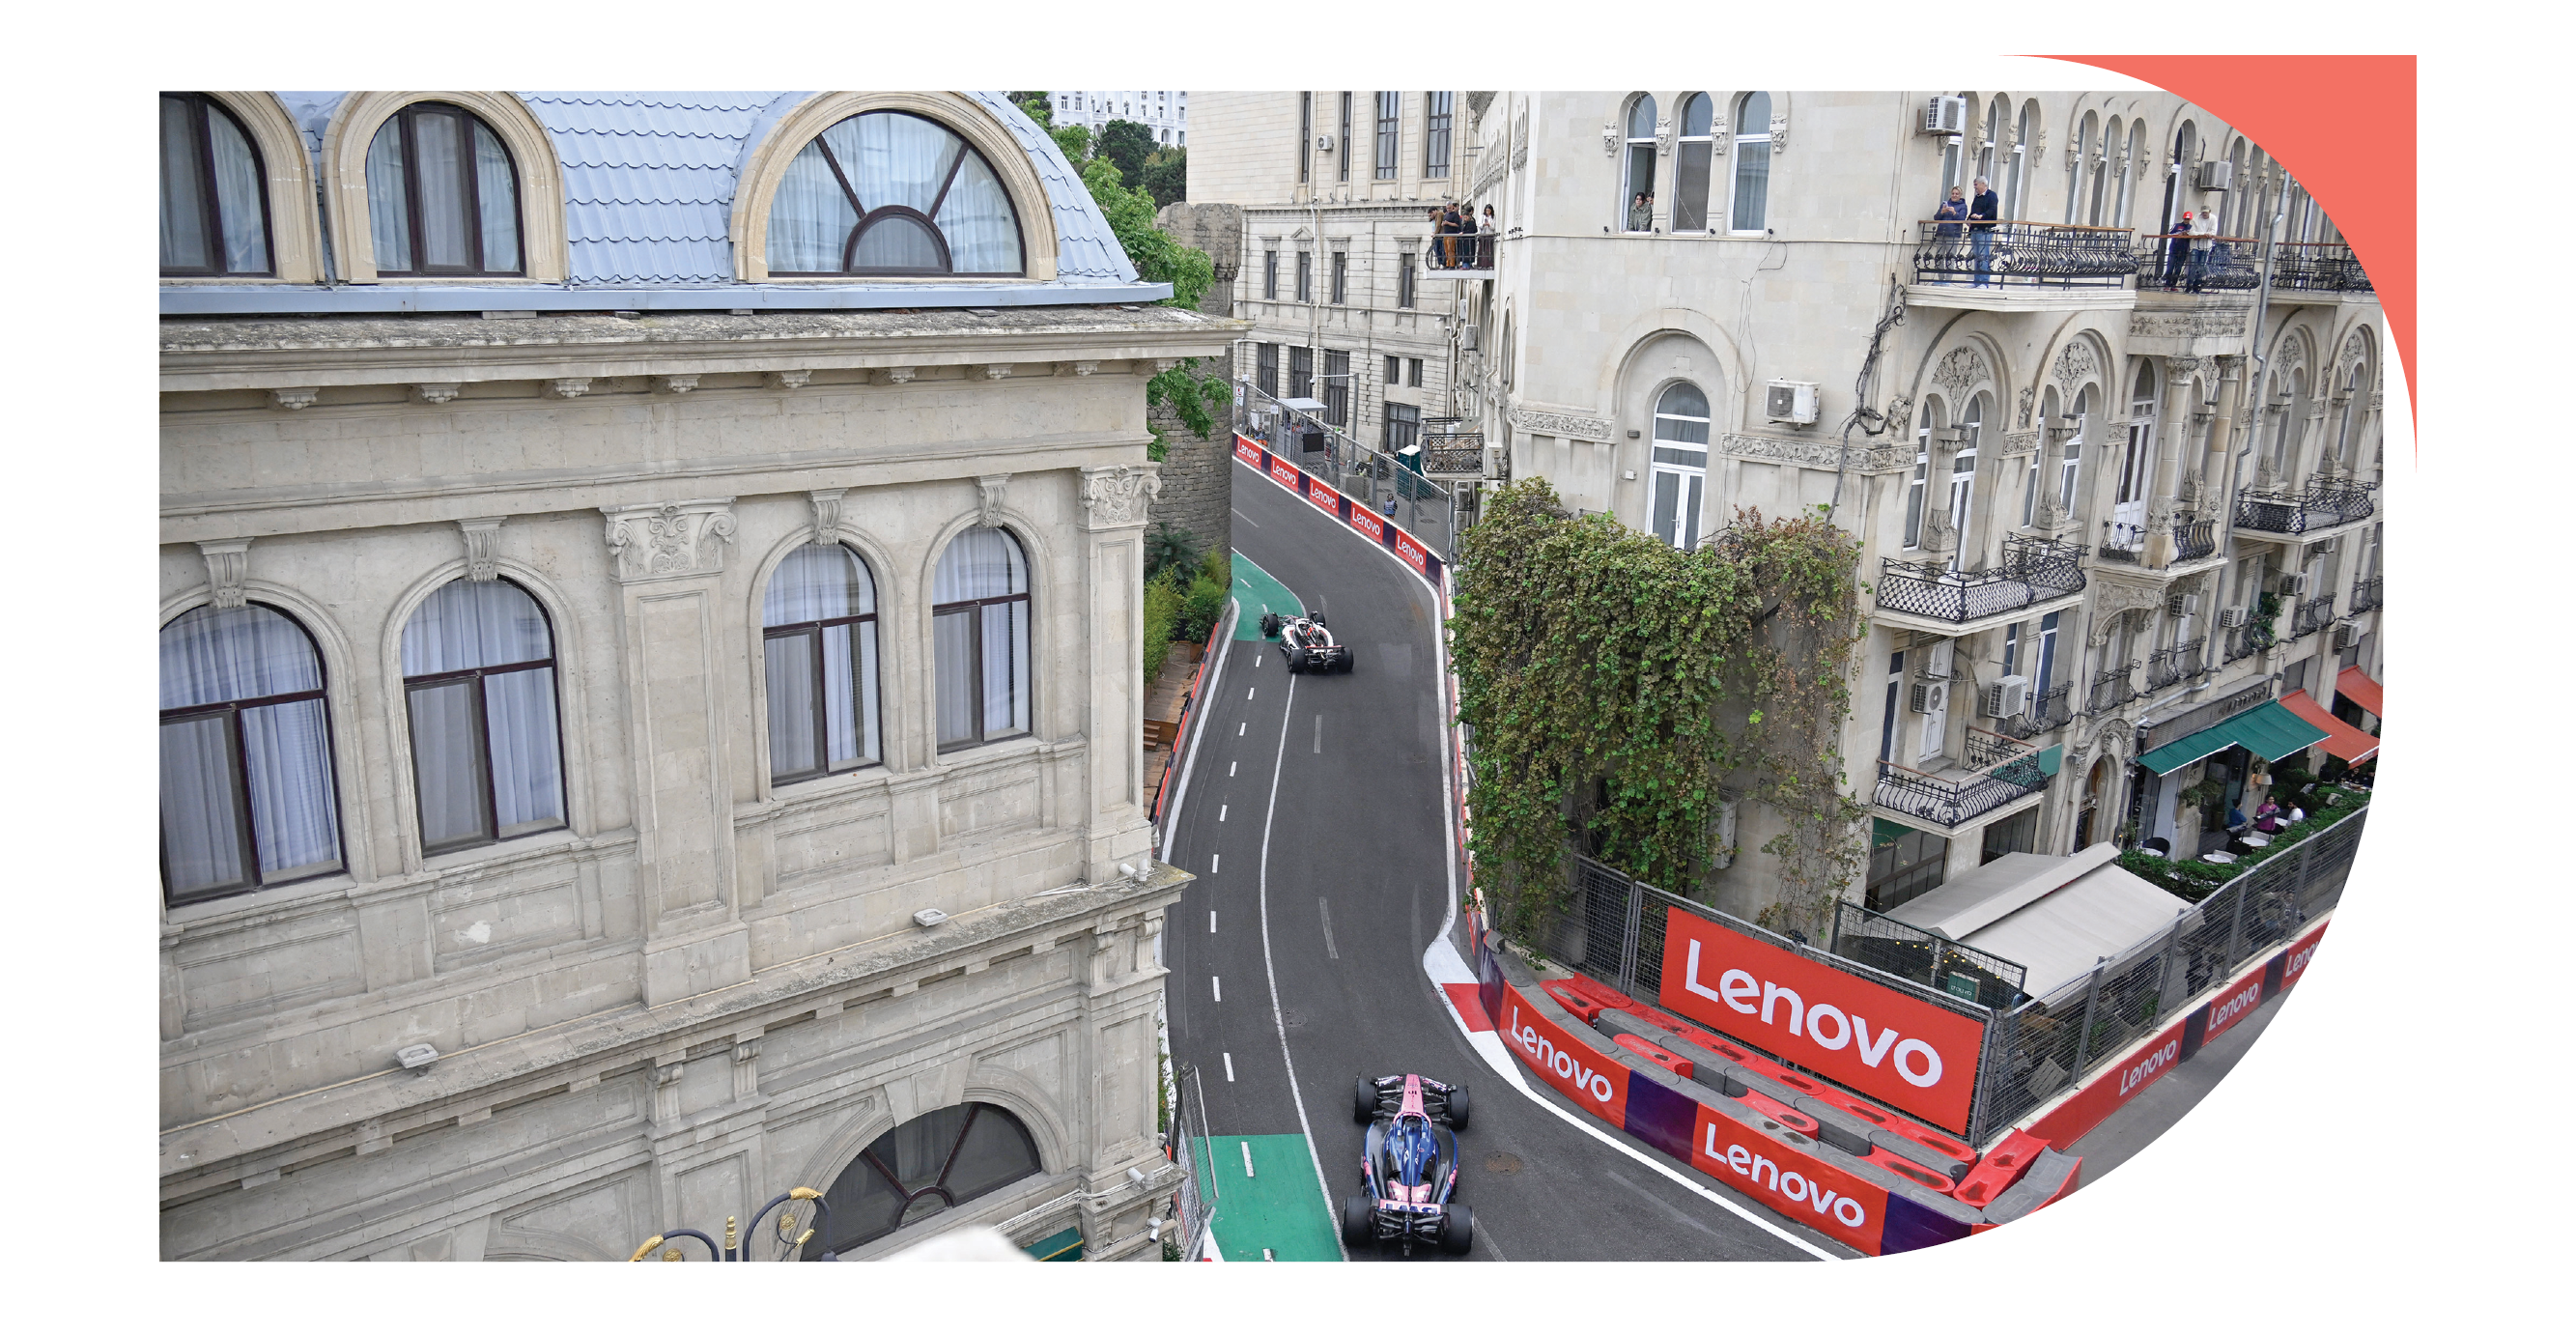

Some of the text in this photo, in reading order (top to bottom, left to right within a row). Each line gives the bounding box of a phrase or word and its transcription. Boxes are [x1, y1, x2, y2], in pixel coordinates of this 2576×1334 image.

[1237, 440, 1260, 463] Lenovo
[1272, 461, 1297, 486] Lenovo
[1310, 482, 1337, 509] Lenovo
[1352, 507, 1381, 536] Lenovo
[1397, 534, 1424, 566] Lenovo
[1685, 938, 1943, 1089] Lenovo
[2208, 982, 2258, 1032] Lenovo
[1512, 1007, 1614, 1103] Lenovo
[2118, 1039, 2177, 1097] Lenovo
[1705, 1121, 1865, 1228] Lenovo
